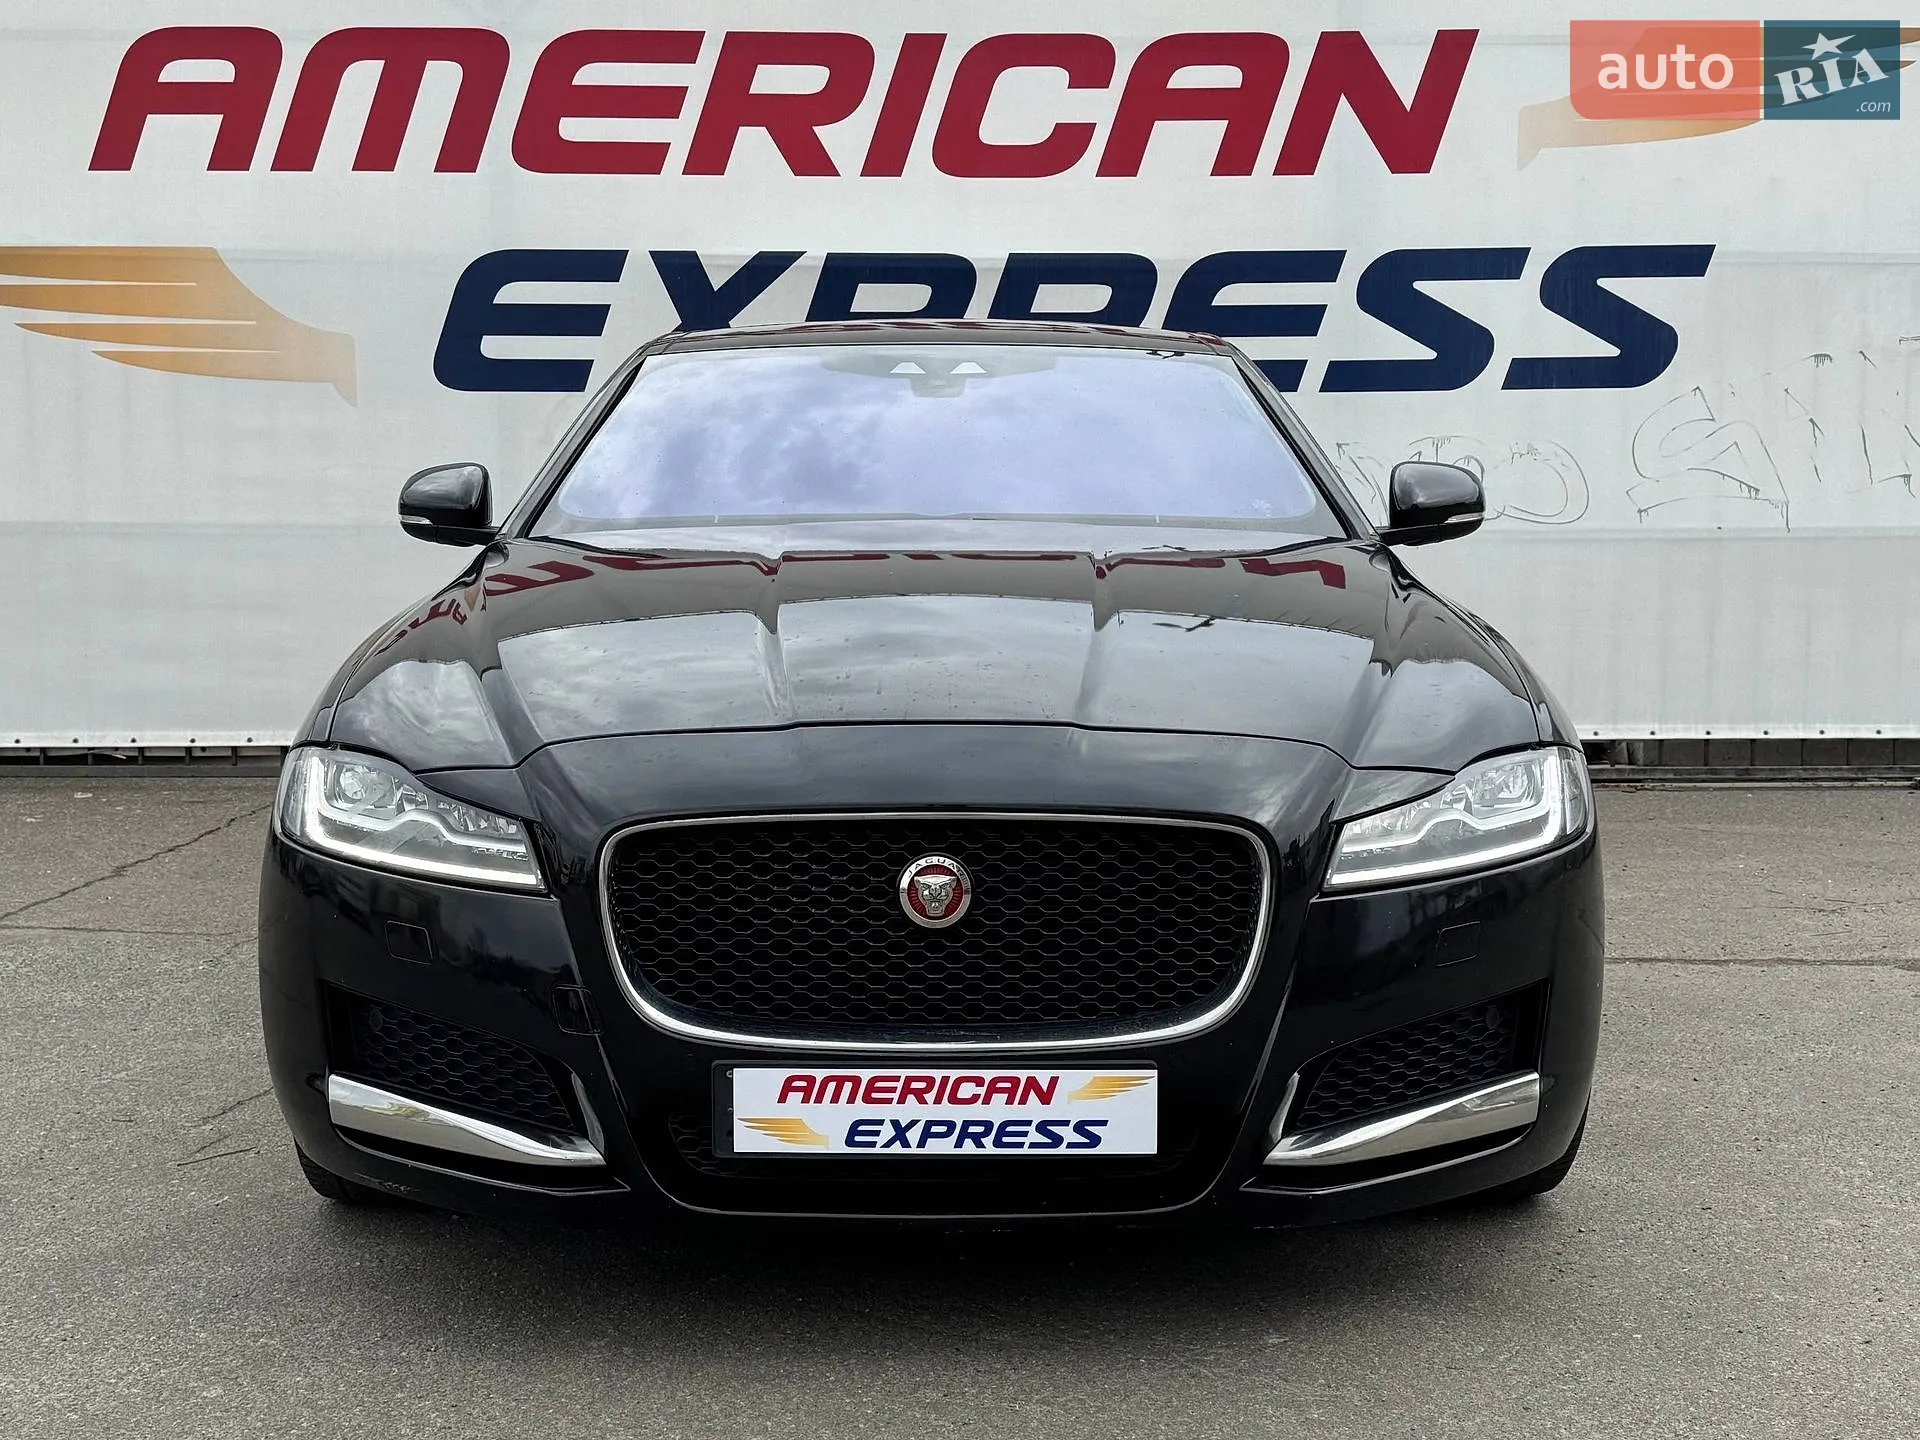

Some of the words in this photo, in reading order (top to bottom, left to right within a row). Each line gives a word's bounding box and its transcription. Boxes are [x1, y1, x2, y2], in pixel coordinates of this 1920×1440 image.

[88, 26, 1479, 177] AMERICAN
[777, 1074, 1059, 1105] AMERICAN
[844, 1118, 1109, 1149] EXPRESS
